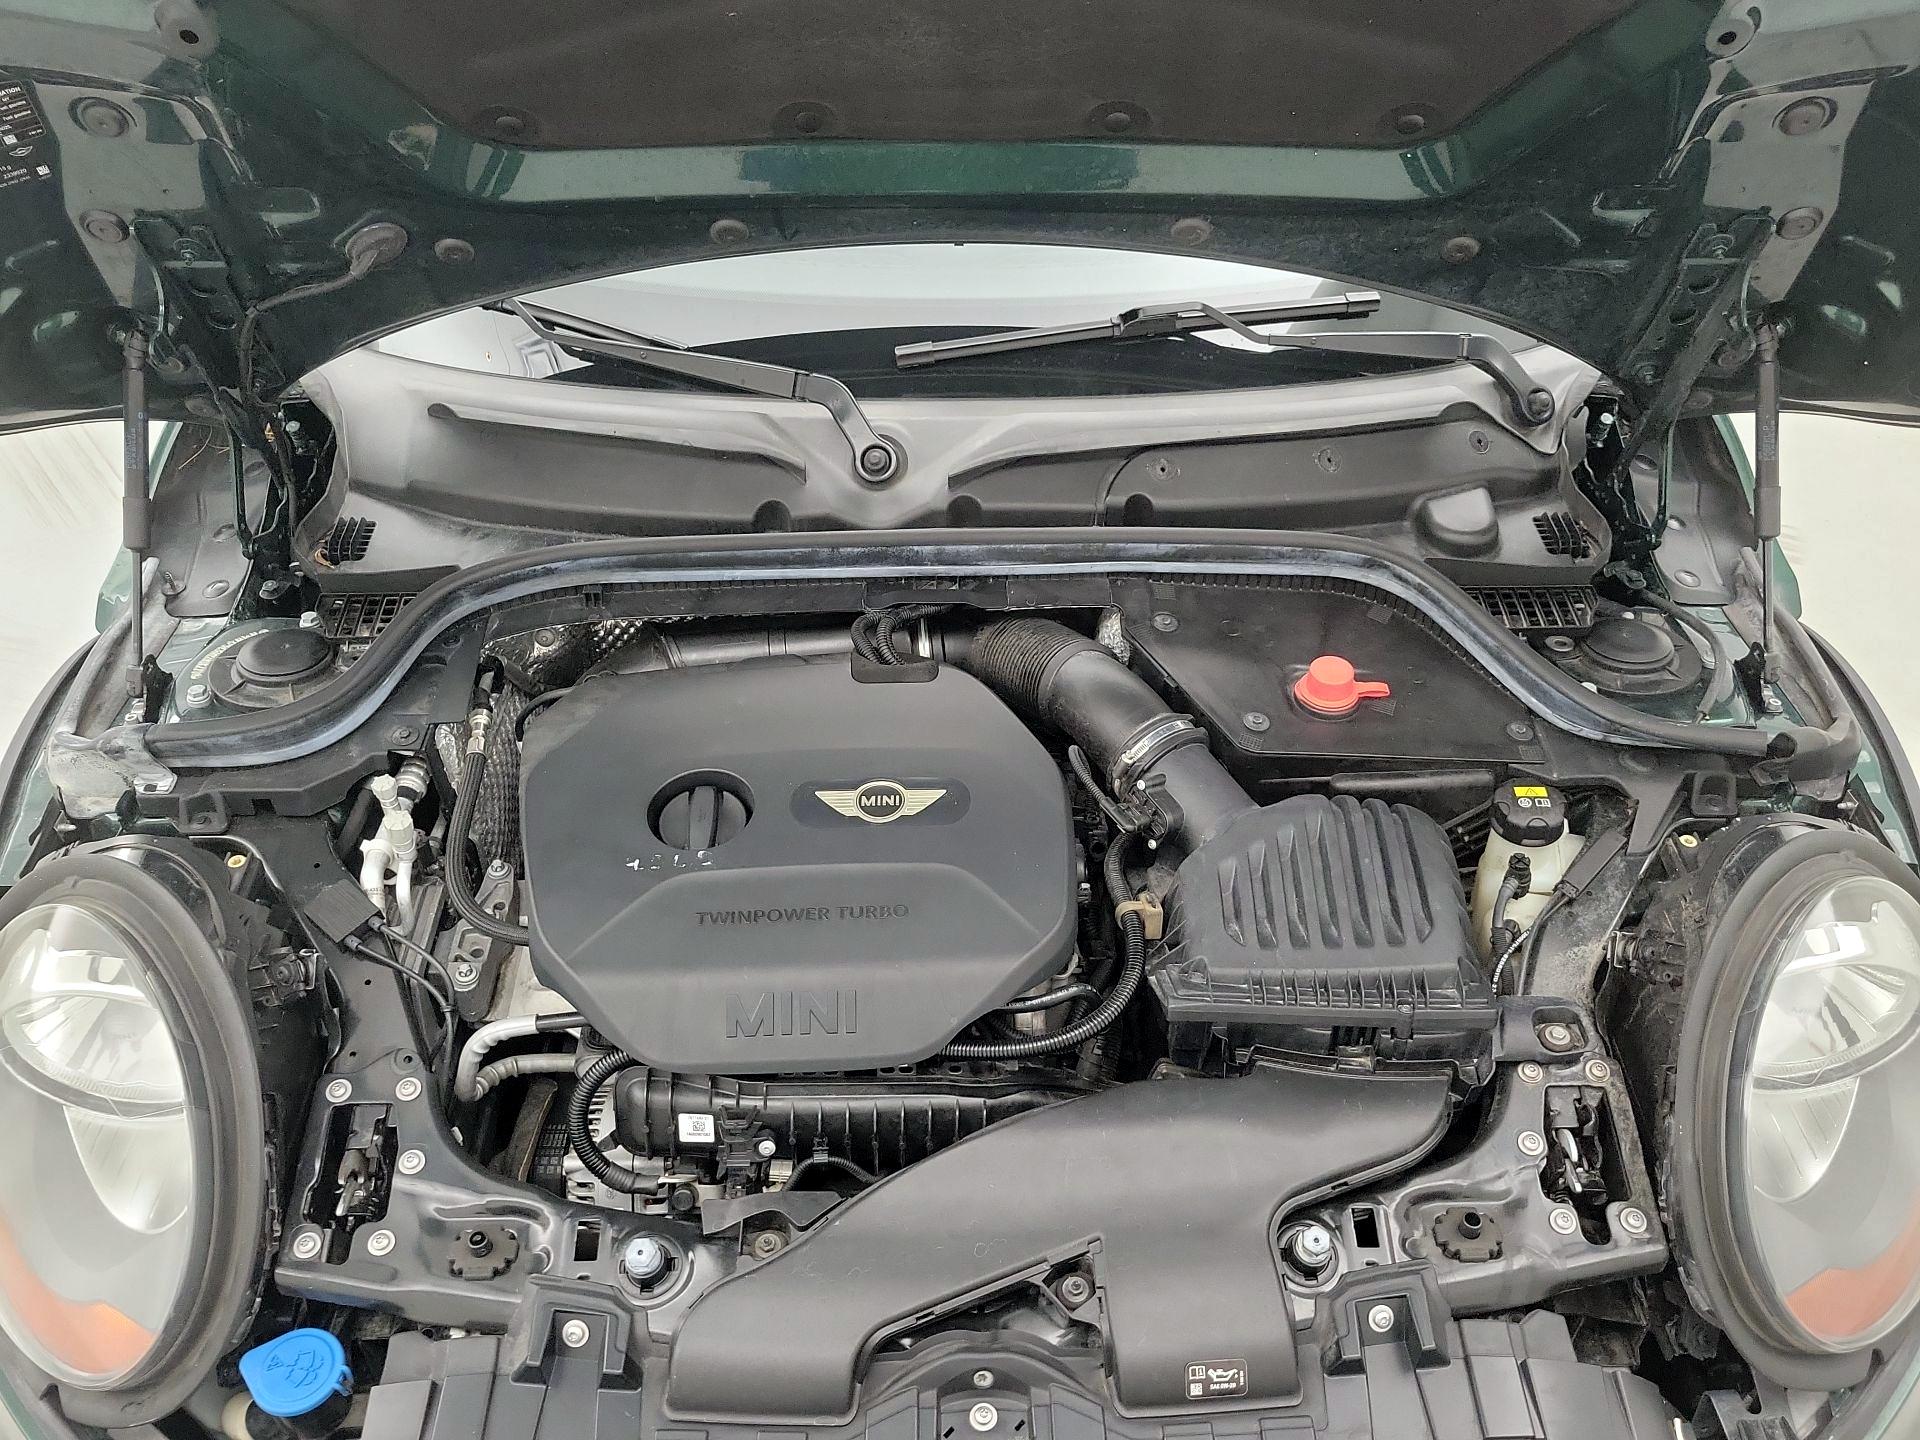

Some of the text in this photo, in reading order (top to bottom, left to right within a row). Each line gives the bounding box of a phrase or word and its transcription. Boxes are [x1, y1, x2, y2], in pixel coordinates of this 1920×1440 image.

[861, 794, 900, 807] MINI
[695, 904, 909, 926] TWINPOWER TURBO
[725, 990, 857, 1038] MINI
